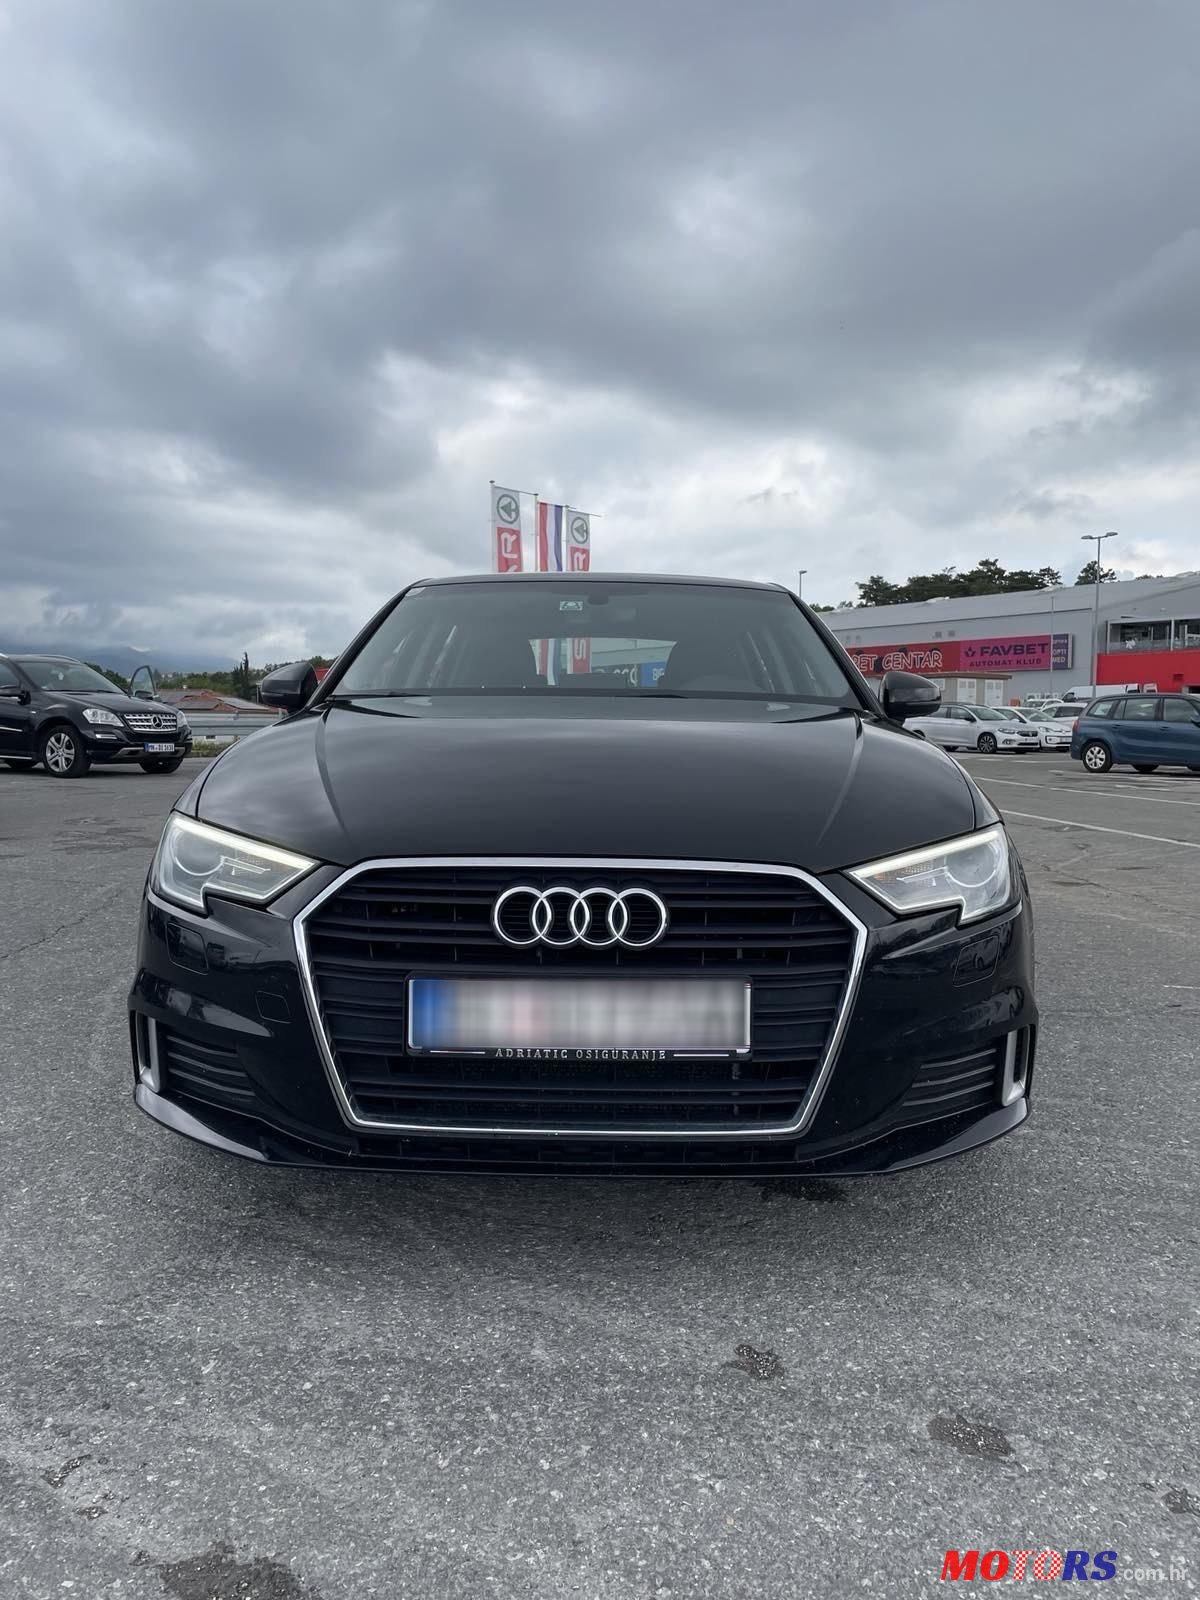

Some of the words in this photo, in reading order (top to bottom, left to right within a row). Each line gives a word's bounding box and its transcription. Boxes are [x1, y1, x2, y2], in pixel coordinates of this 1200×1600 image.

[980, 643, 1049, 657] FAVBET
[882, 650, 943, 670] CENTAR
[969, 659, 1013, 668] AUTOMAT
[1016, 657, 1042, 666] KLUB
[495, 1048, 568, 1059] ADRIATIC
[575, 1049, 666, 1061] OSIGURANJE
